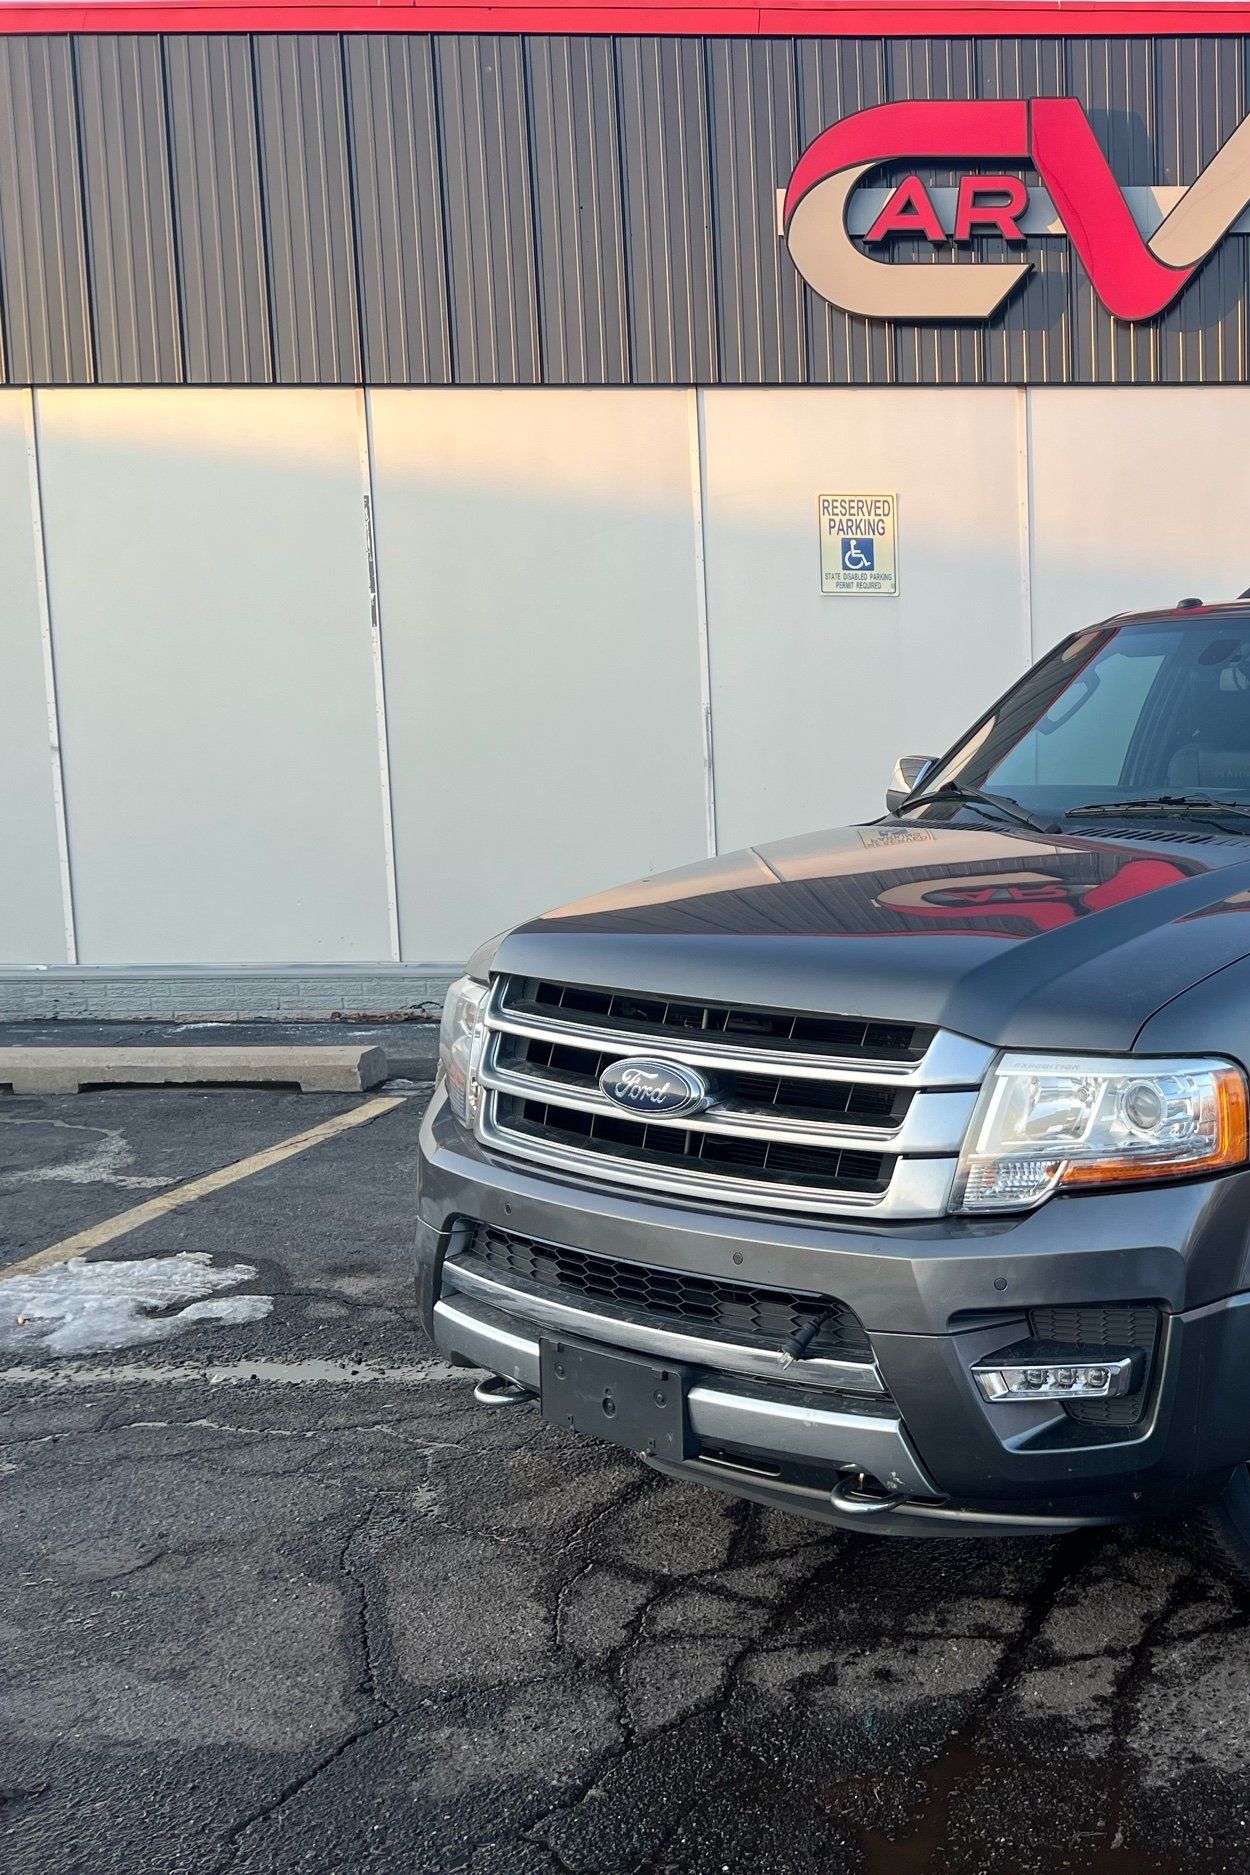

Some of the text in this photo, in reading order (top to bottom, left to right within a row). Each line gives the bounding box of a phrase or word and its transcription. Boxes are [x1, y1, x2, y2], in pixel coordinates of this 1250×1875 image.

[822, 499, 891, 517] RESERVED
[828, 518, 886, 536] PARKING
[870, 573, 892, 581] PARKING
[614, 1068, 671, 1104] Ford
